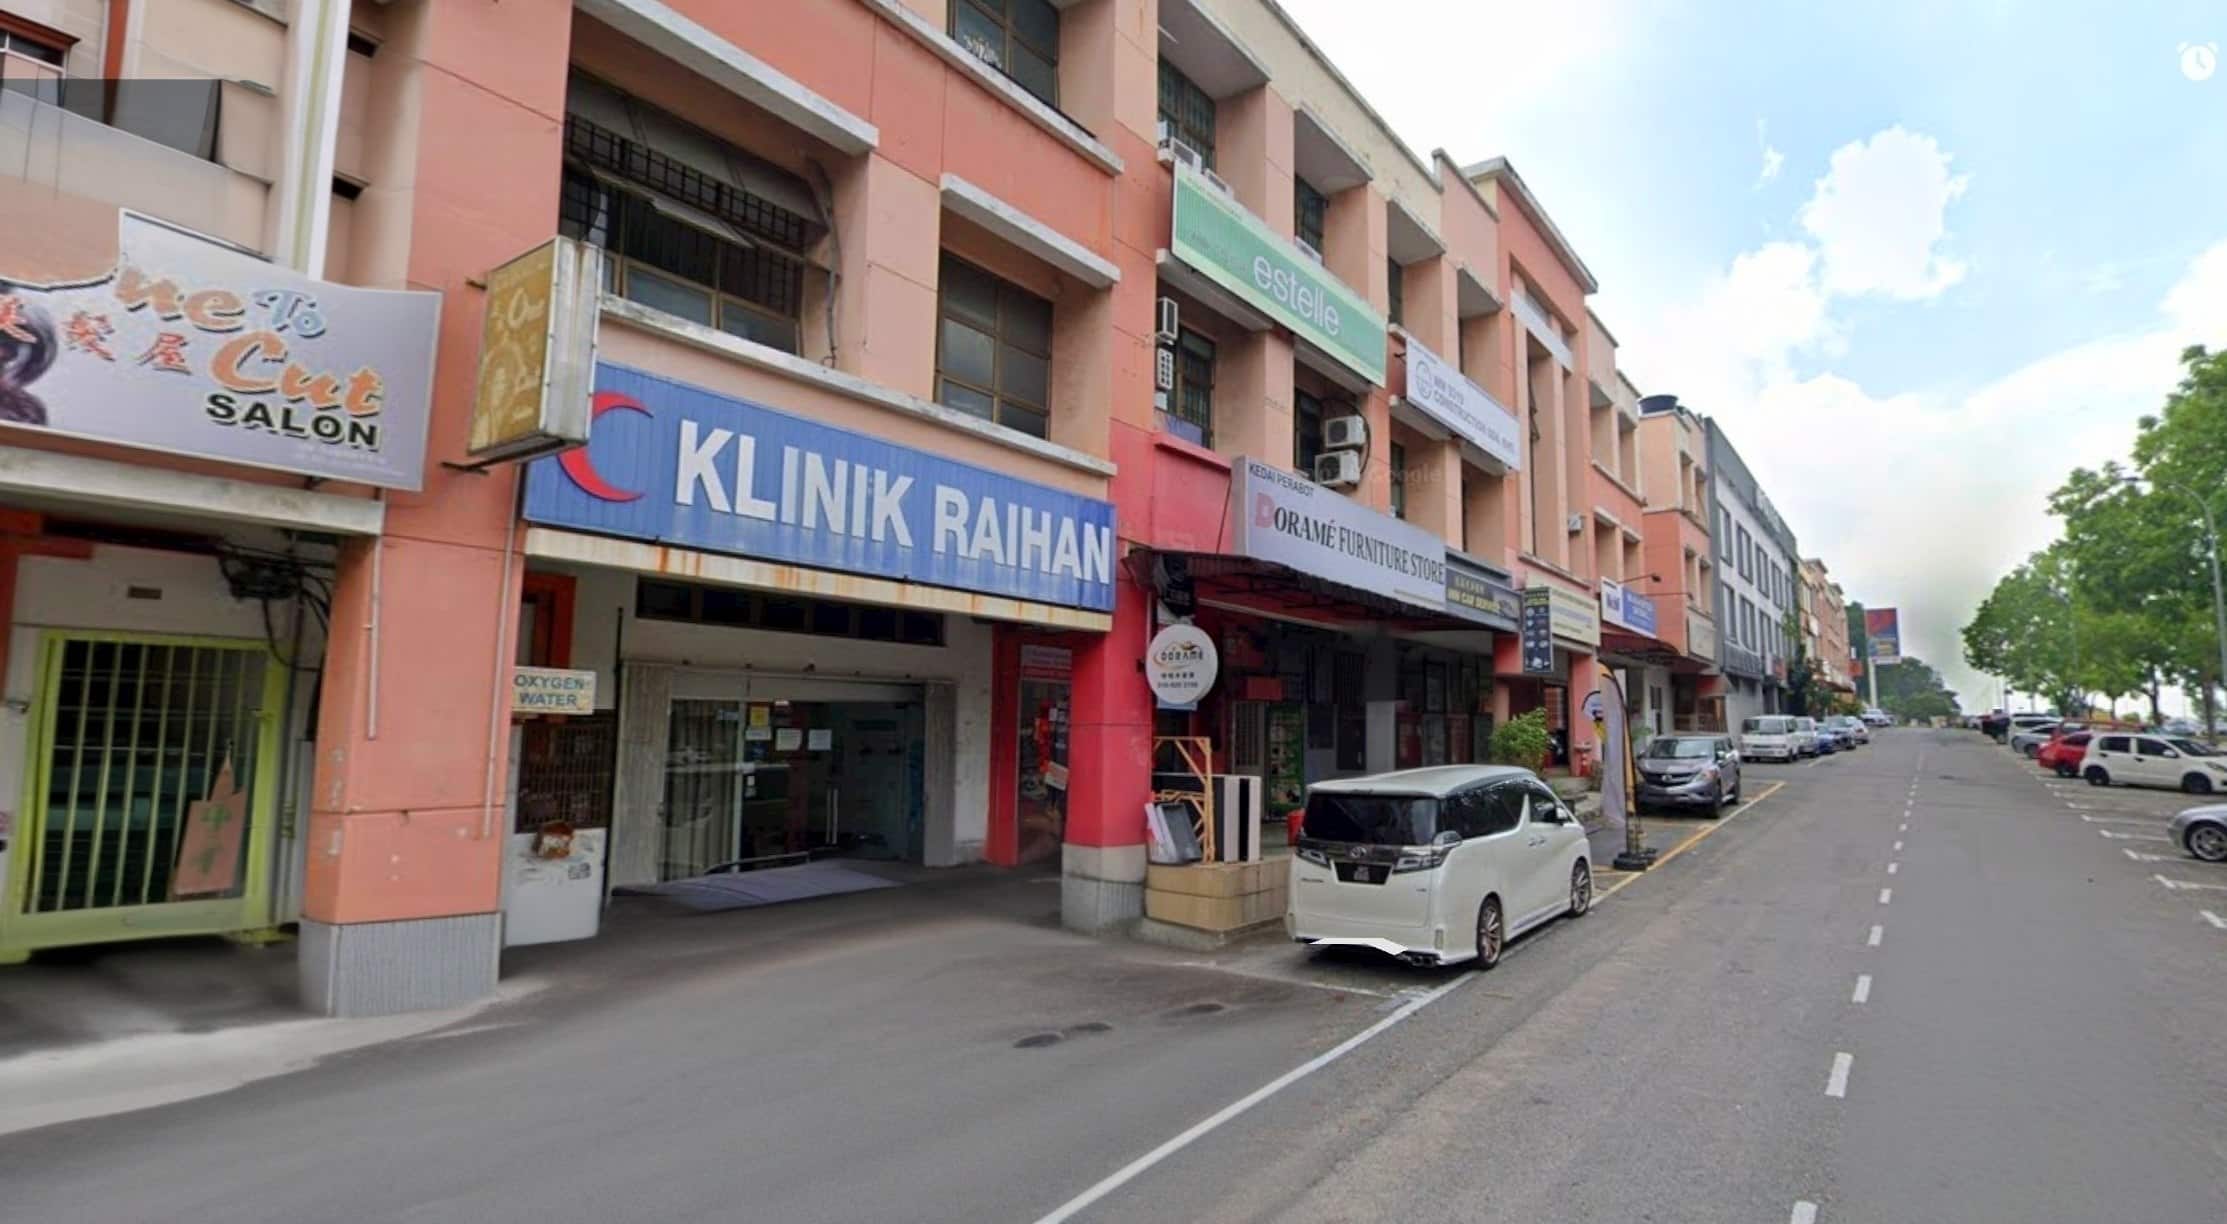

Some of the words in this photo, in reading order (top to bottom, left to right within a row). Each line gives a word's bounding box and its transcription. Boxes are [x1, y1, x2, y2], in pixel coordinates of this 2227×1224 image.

[1253, 255, 1340, 337] estelle
[207, 330, 384, 417] Cut
[205, 393, 380, 452] SALON
[675, 418, 915, 547] KLINIK
[933, 484, 1111, 584] RAIHAN
[1249, 463, 1277, 484] KEDAI
[1277, 472, 1315, 497] PERABOT
[1255, 492, 1336, 549] DORAMÉ
[1338, 526, 1409, 575] FURNITURE
[1410, 552, 1446, 585] STORE
[514, 674, 584, 690] OXYGEN
[520, 692, 578, 705] WATER
